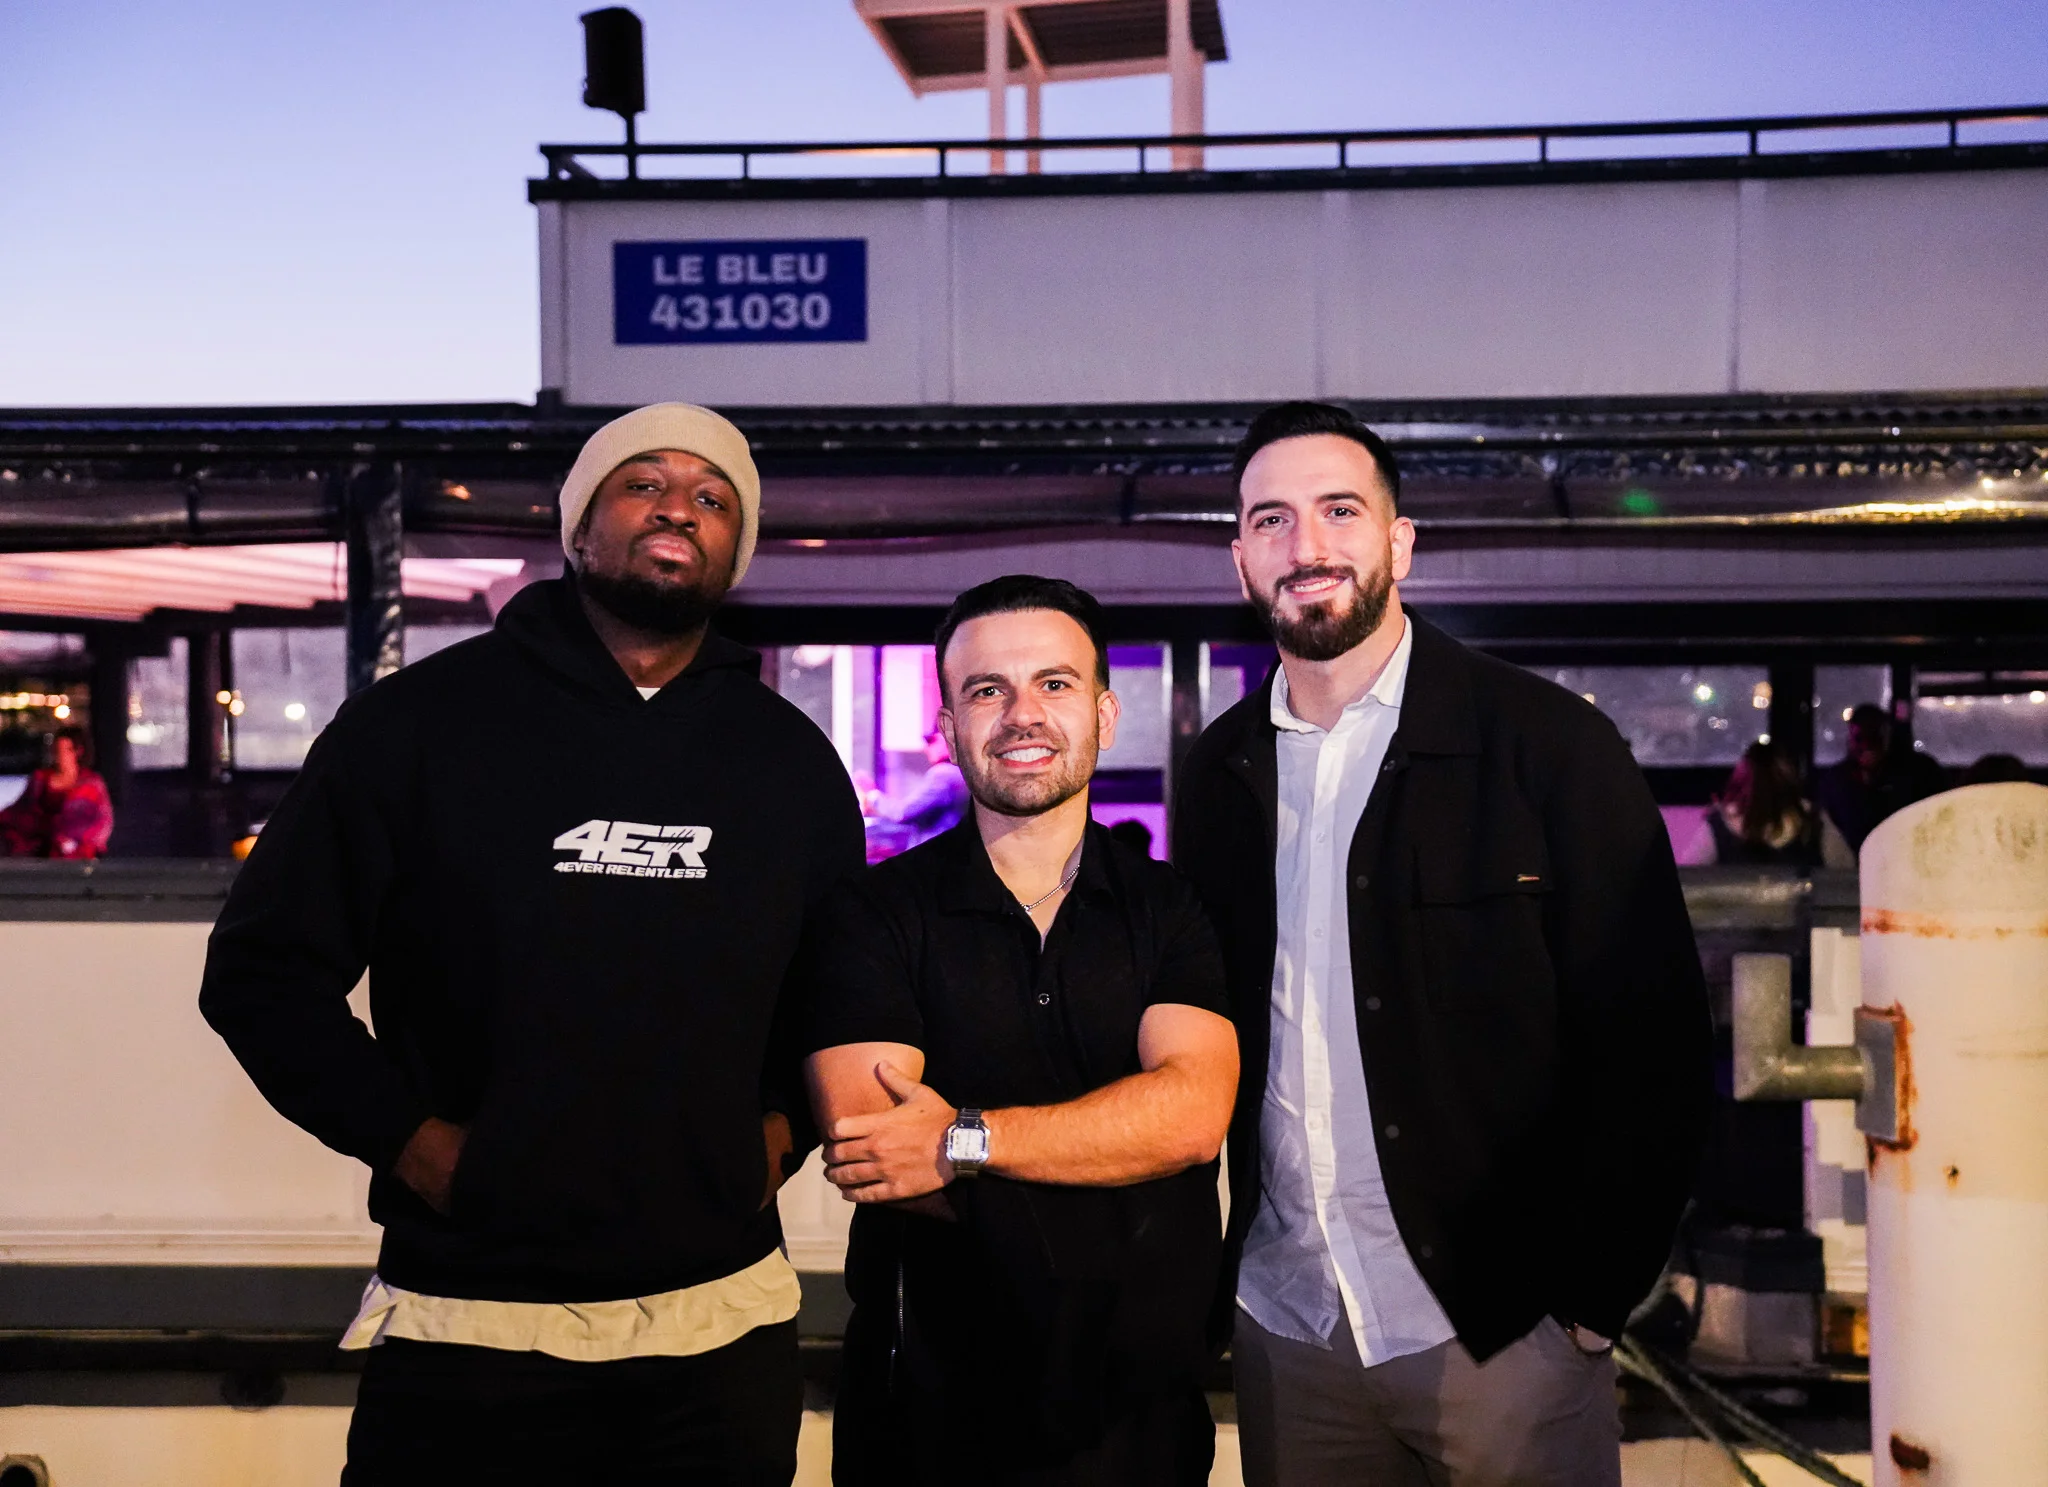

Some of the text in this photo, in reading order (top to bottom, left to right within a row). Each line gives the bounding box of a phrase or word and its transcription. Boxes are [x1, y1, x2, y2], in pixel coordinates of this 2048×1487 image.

[653, 252, 828, 285] LE BLEU
[650, 292, 831, 330] 431030
[552, 819, 713, 867] 4ER
[553, 861, 708, 879] 4EVER RELENTLESS
